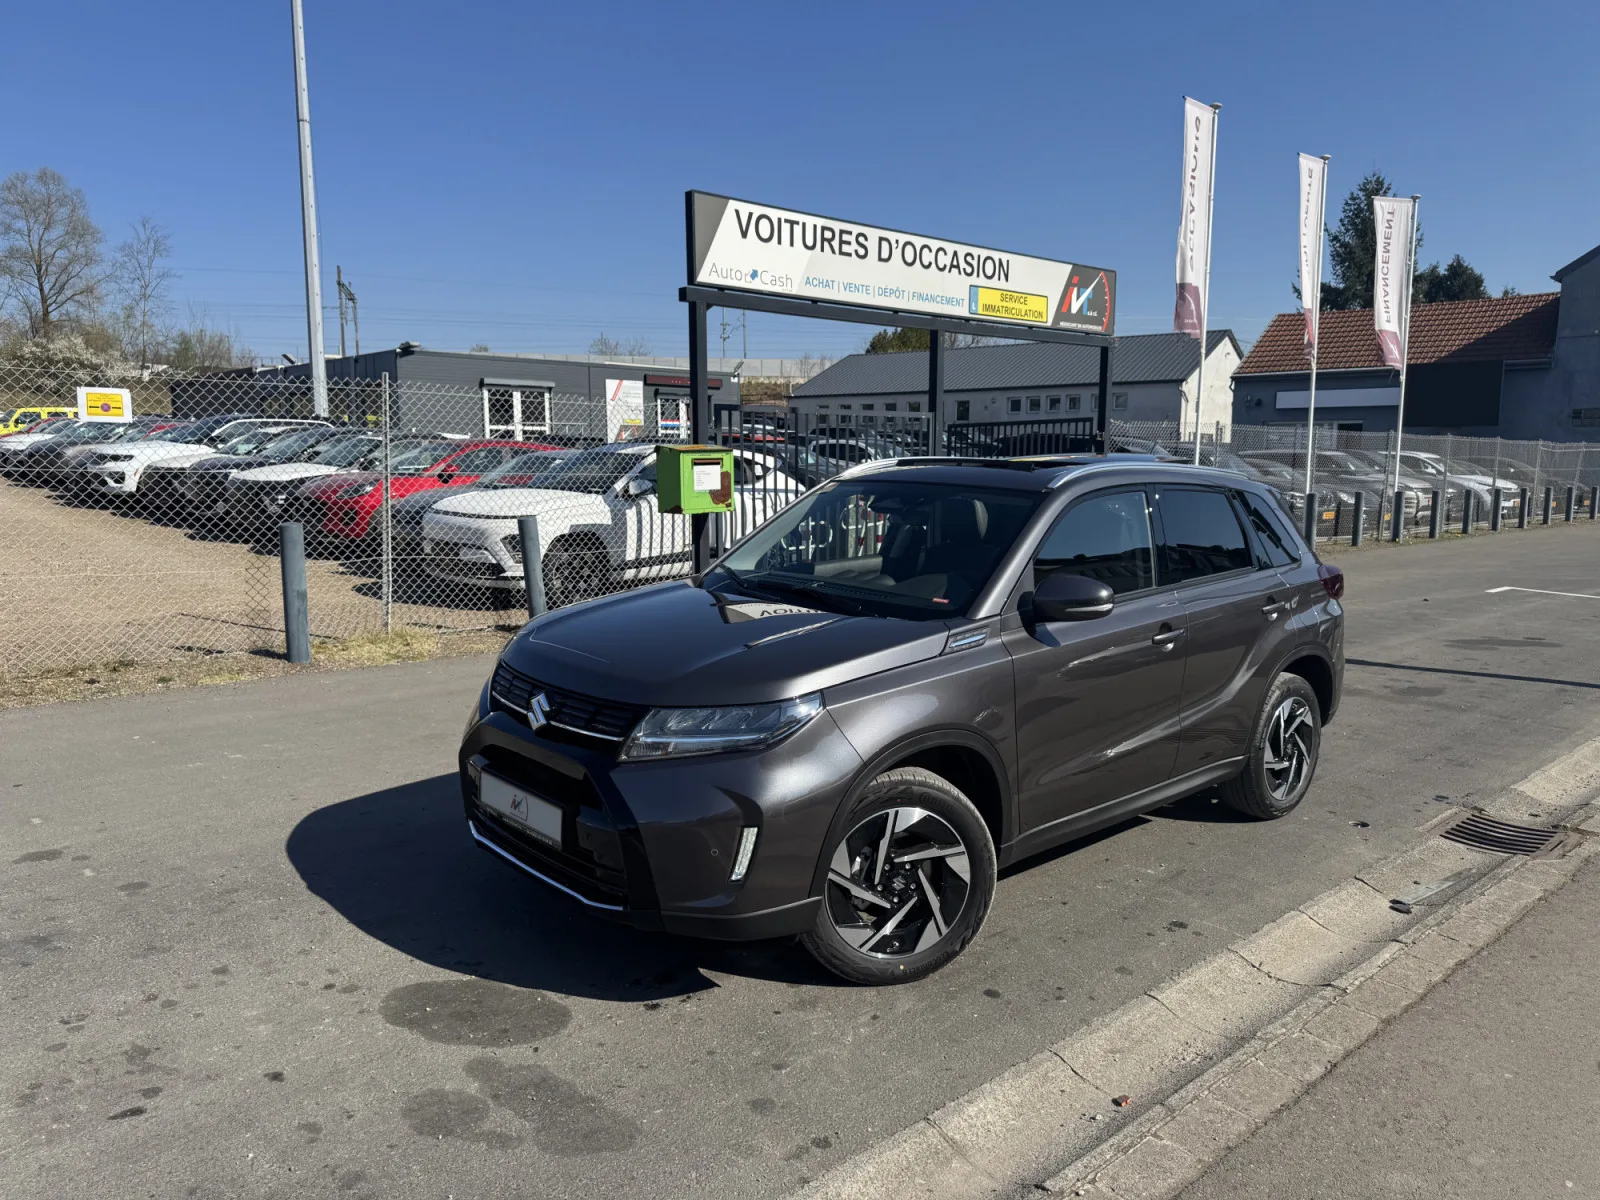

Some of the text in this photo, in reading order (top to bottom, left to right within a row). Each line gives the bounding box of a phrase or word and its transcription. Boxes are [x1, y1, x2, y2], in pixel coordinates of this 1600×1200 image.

[734, 208, 1010, 282] VOITURES D’OCCASION
[708, 262, 793, 289] Auto Cash
[804, 276, 965, 308] ACHAT VENTE DÉPÔT FINANCEMENT
[1000, 293, 1028, 305] SERVICE
[982, 303, 1043, 319] IMMATRICULATION
